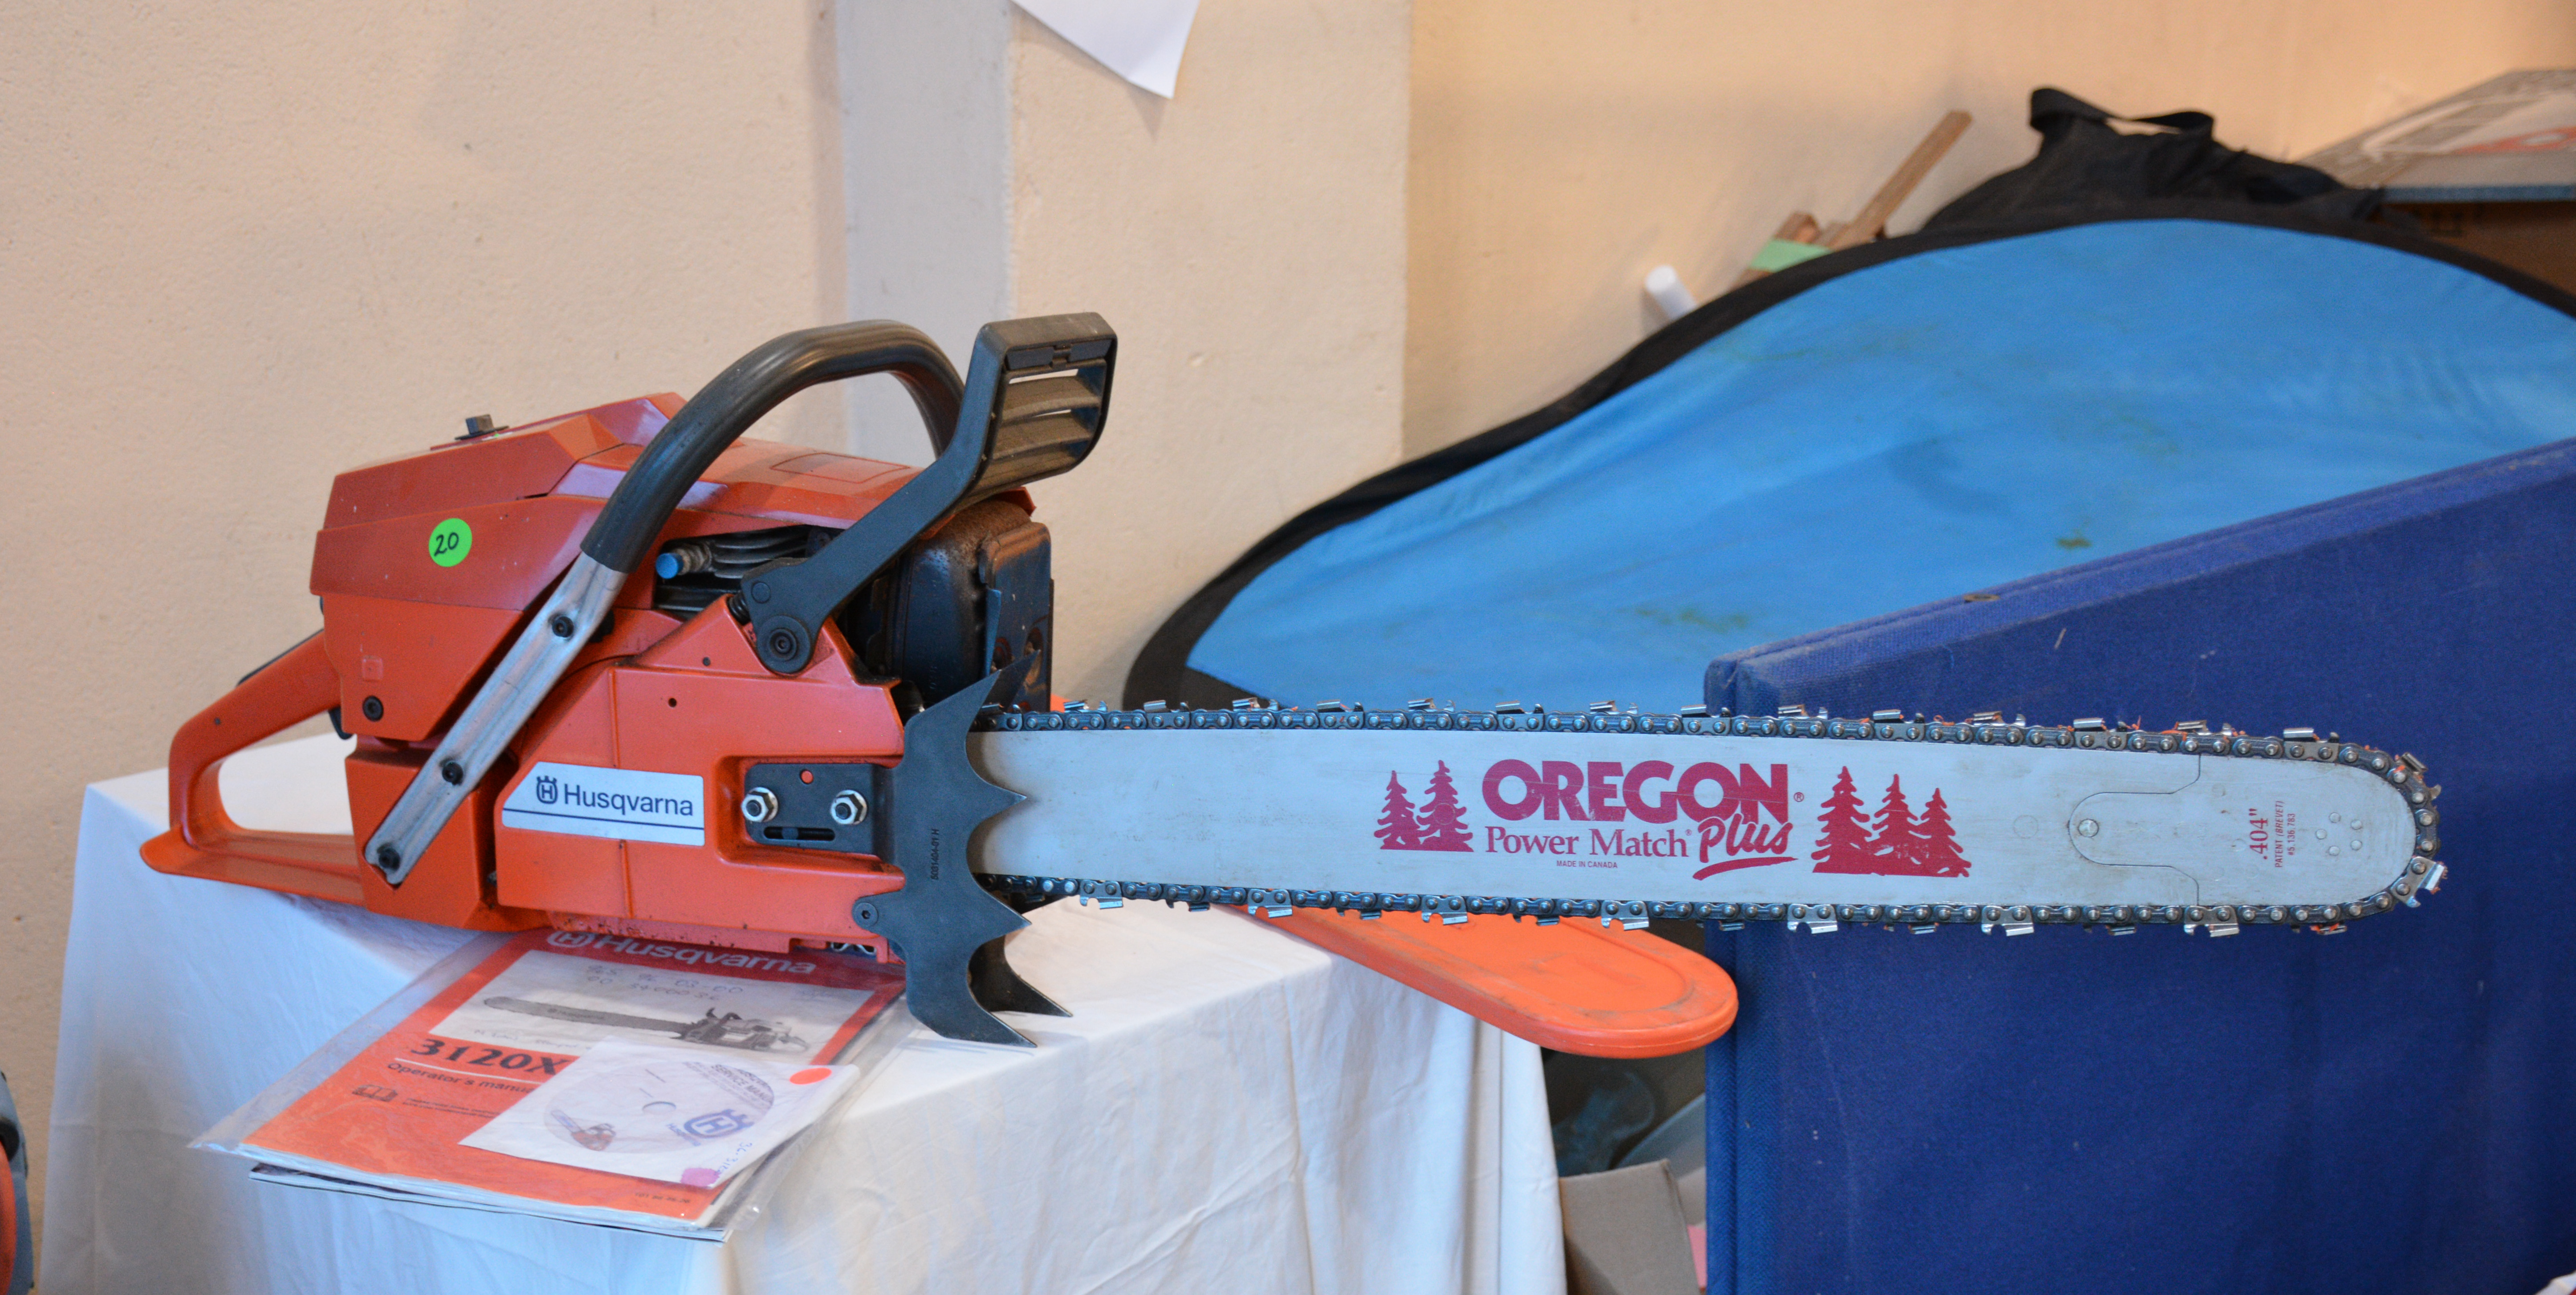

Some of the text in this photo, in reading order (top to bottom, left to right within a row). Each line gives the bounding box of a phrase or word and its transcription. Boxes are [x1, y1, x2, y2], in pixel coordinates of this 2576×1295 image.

[434, 532, 460, 556] 20
[564, 783, 693, 816] Husqvarna
[1482, 759, 1788, 824] OREGON
[1485, 826, 1579, 855] Power
[2275, 801, 2285, 868] PATENT (BREVET)
[594, 935, 817, 974] Husqvarna
[387, 1062, 474, 1086] Operator's
[411, 1038, 570, 1075] 3120X
